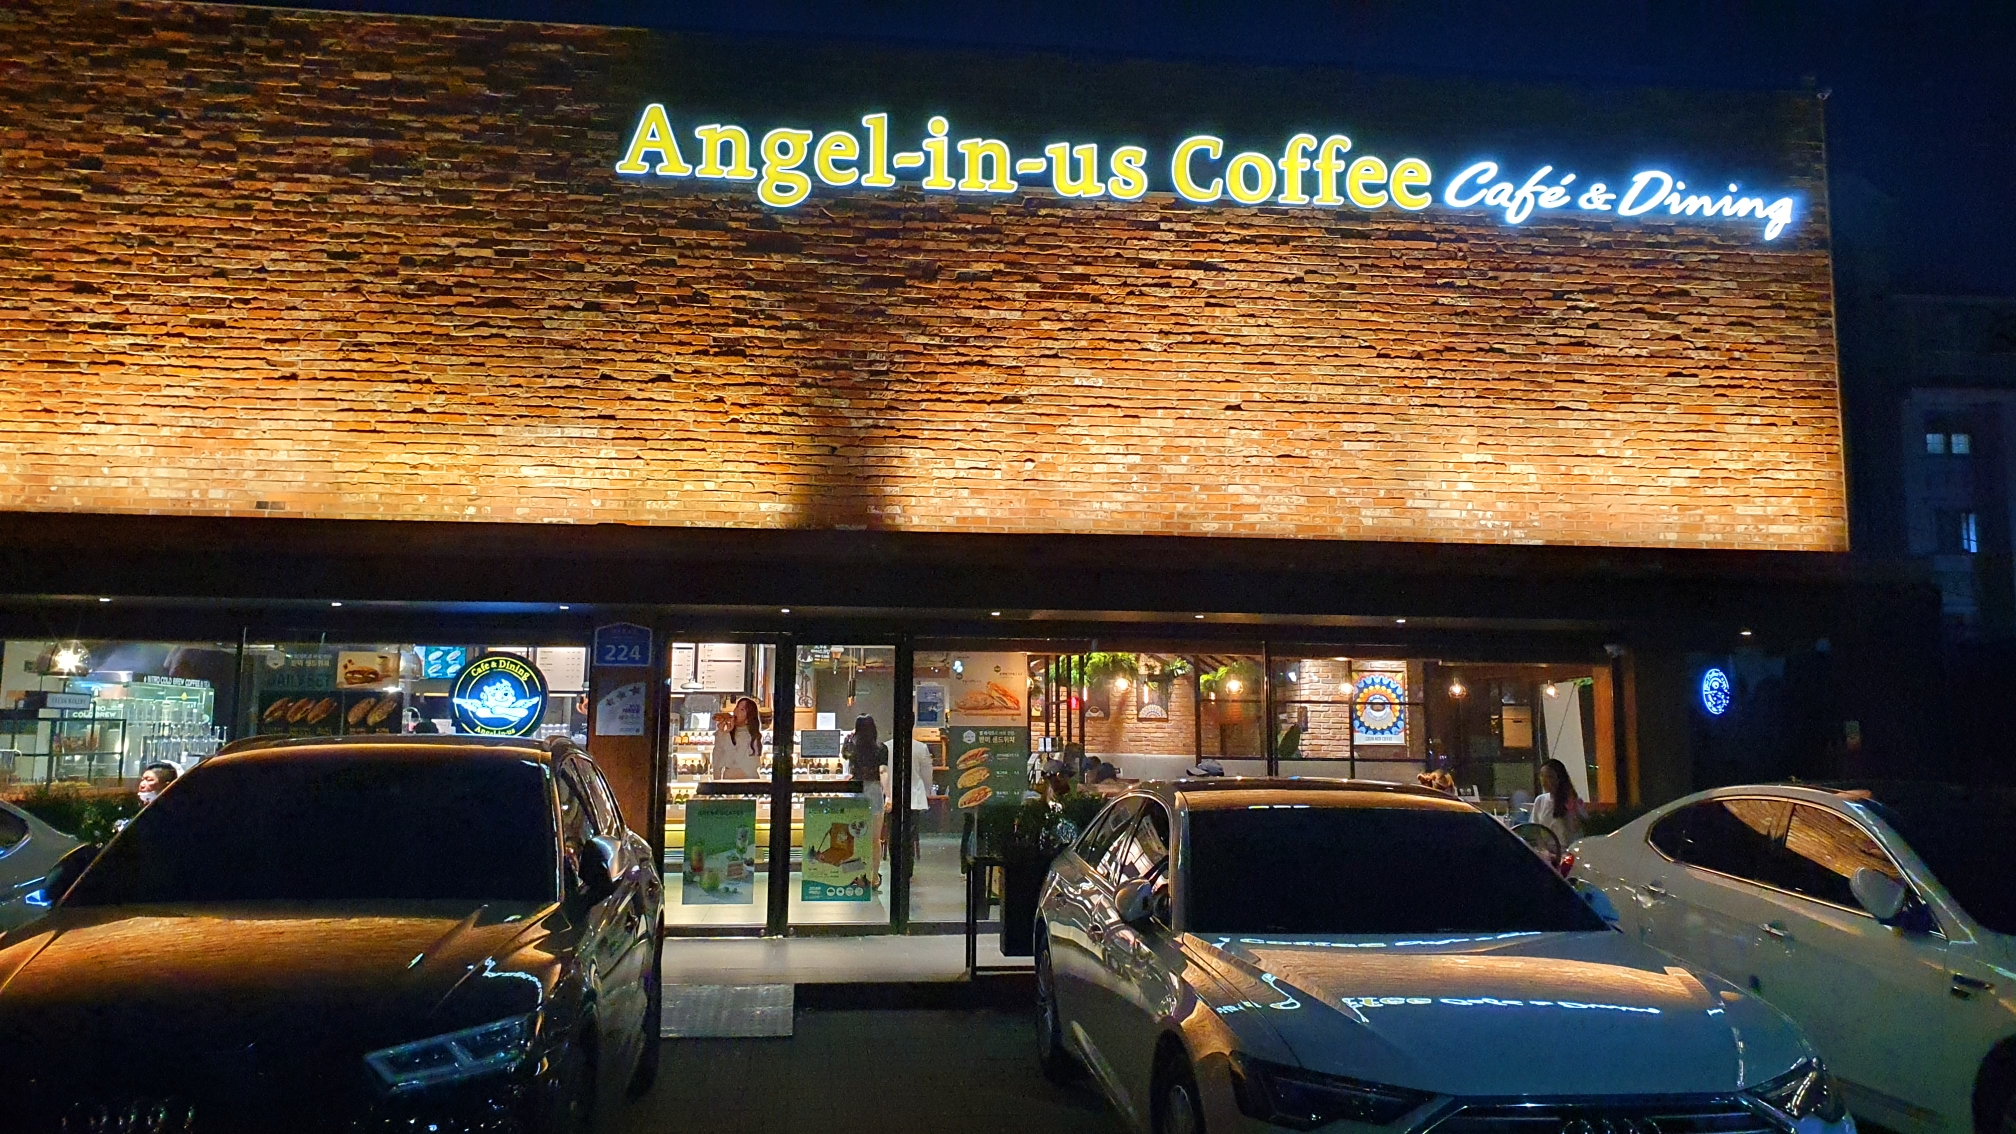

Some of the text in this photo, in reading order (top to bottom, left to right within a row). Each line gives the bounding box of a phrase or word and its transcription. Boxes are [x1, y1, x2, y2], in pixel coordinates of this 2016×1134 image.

[615, 103, 1796, 242] Angel-in-us Coffee Café & Dining
[604, 644, 642, 661] 224
[490, 660, 497, 668] &
[499, 659, 531, 681] Dining
